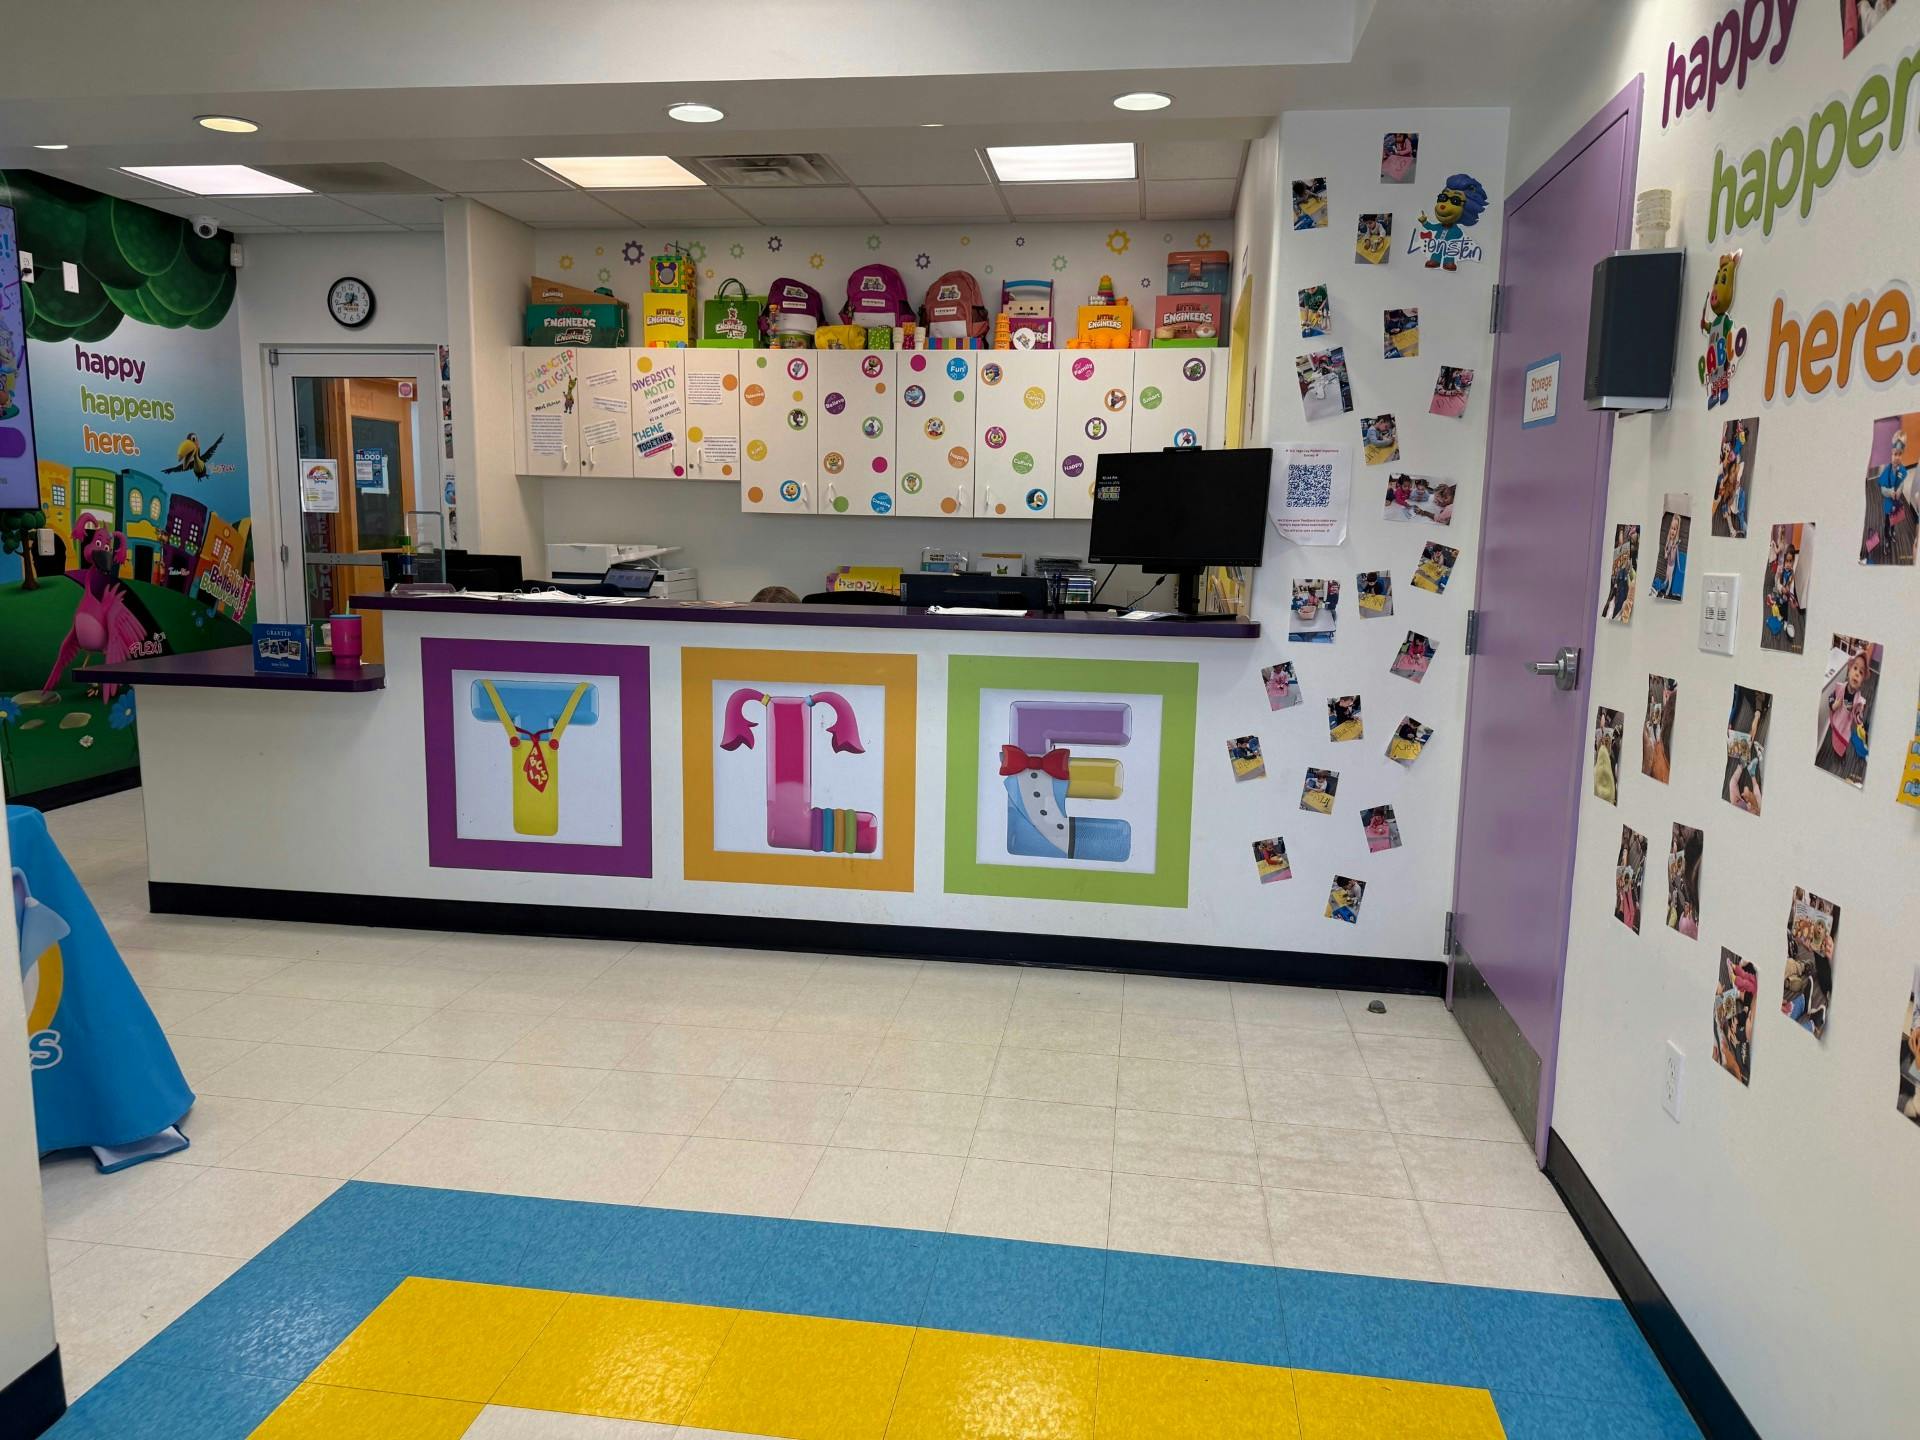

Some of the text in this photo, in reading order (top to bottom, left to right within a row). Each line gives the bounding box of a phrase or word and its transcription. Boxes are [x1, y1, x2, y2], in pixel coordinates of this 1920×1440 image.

[1662, 0, 1797, 128] happy
[656, 308, 675, 316] LITTLE
[1163, 312, 1213, 324] ENGINEERS
[543, 317, 597, 328] ENGINEERS
[646, 316, 685, 326] ENGINEERS
[1087, 320, 1121, 330] ENGINEERS
[75, 344, 145, 384] happy
[1698, 327, 1748, 385] PABLO
[1073, 362, 1092, 376] Family
[631, 364, 677, 392] DIVERSITY
[1531, 375, 1552, 392] Storage
[643, 378, 676, 399] MOTTO
[81, 385, 176, 422] happens
[825, 397, 845, 409] Believe
[1142, 392, 1161, 404] Smart
[1532, 394, 1549, 412] Closet
[83, 425, 140, 456] here.
[632, 422, 665, 442] THEME
[637, 432, 674, 453] TOGETHER
[1013, 457, 1033, 468] Culture
[1063, 461, 1083, 472] Happy
[210, 565, 241, 598] Believe
[838, 576, 880, 592] happy
